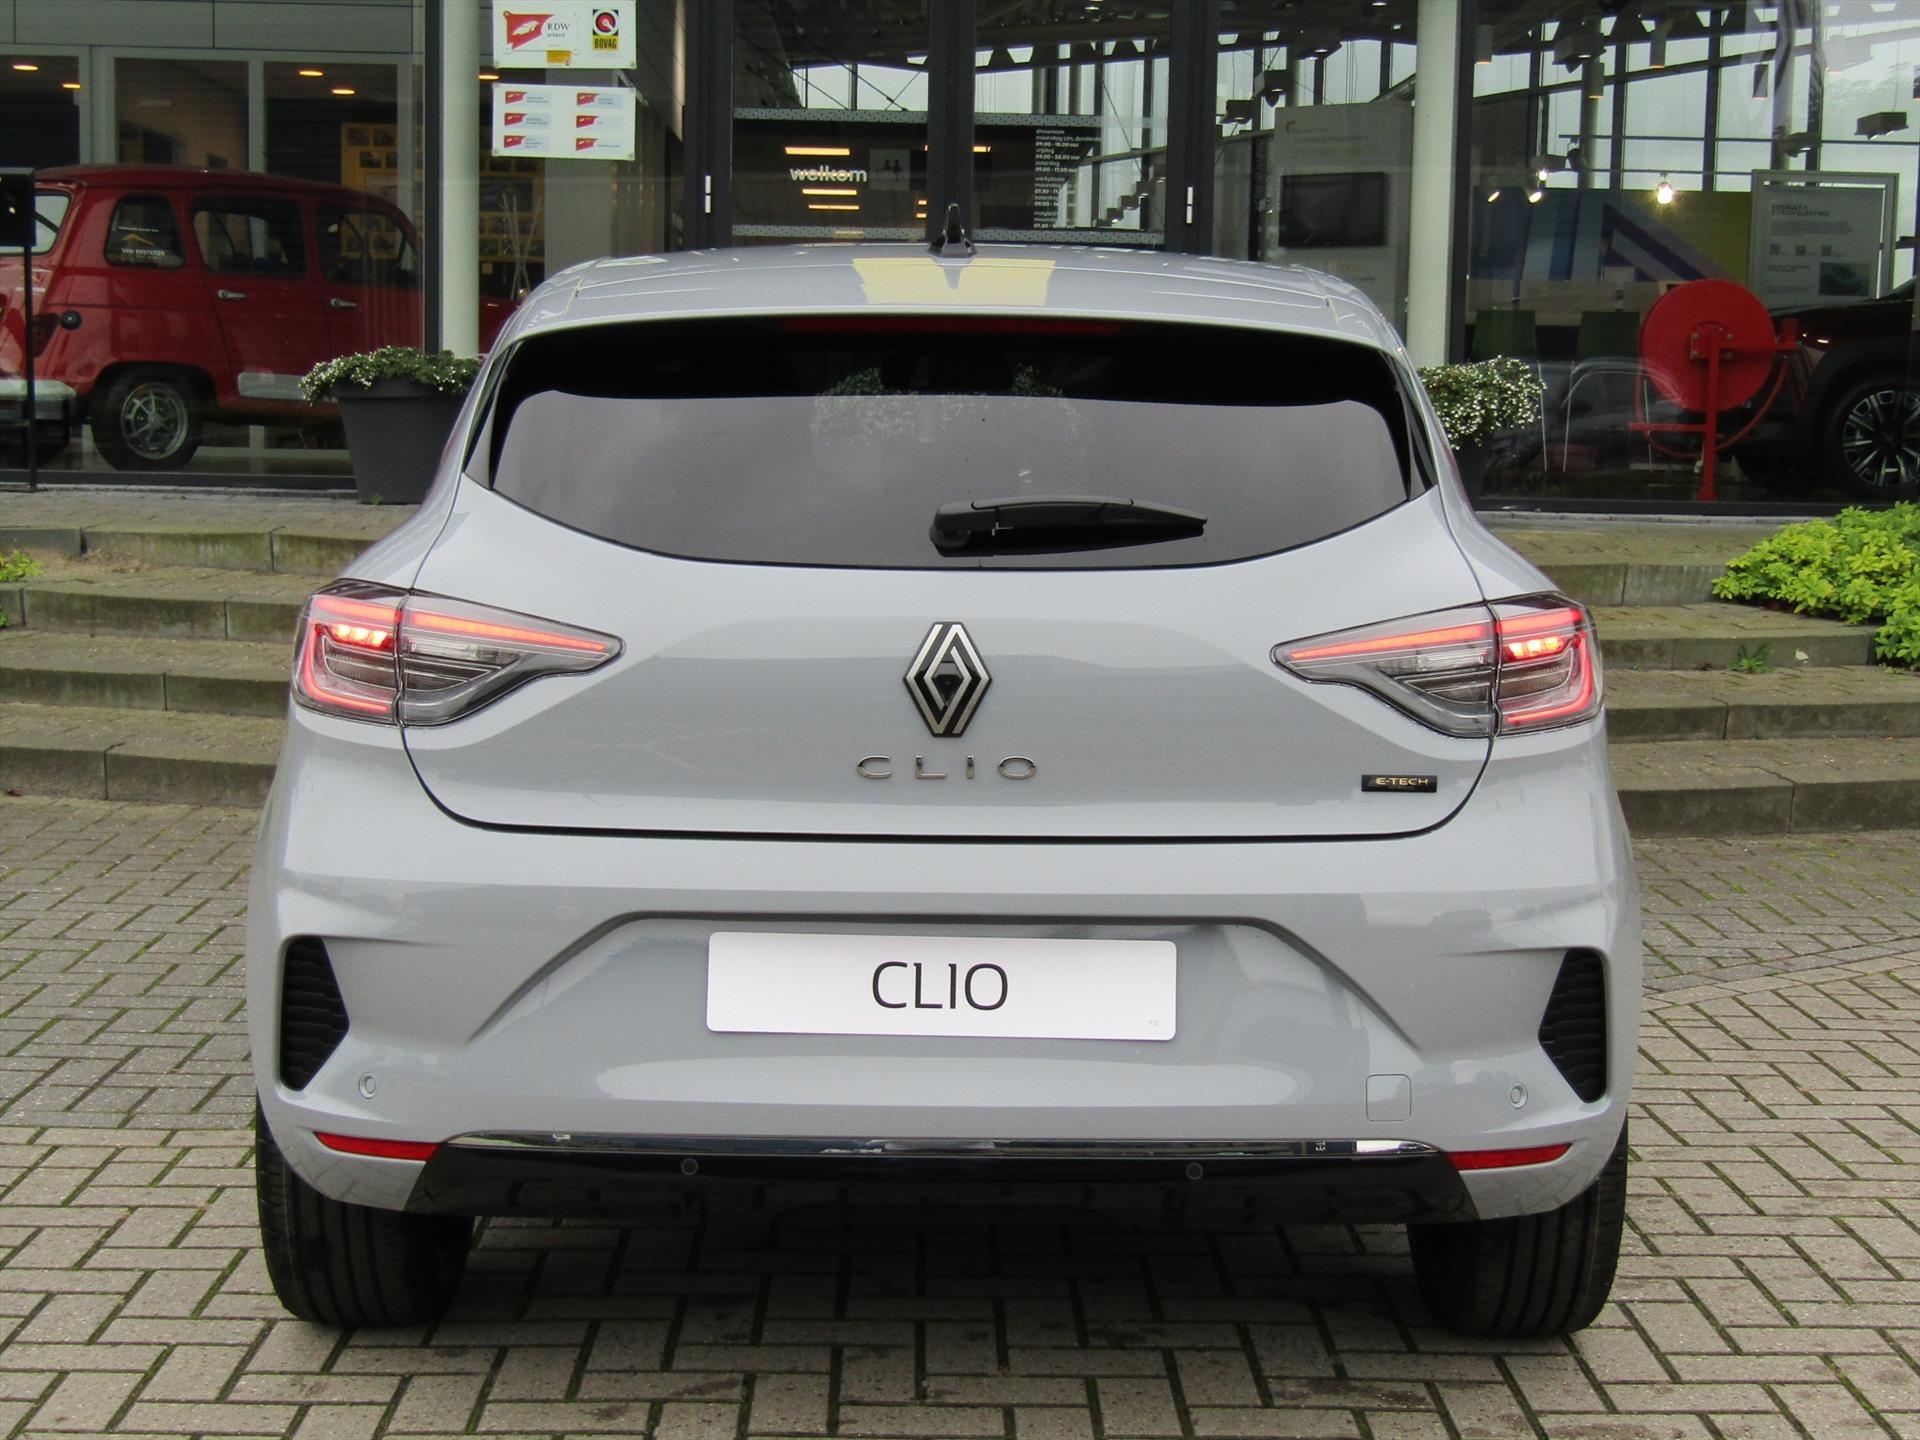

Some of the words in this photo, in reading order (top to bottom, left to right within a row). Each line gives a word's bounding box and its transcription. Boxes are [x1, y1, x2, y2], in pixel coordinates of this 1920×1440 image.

[547, 23, 570, 31] RDW
[594, 38, 617, 49] BOVAG
[790, 165, 867, 182] welkom
[857, 755, 1037, 779] CLIO
[1375, 777, 1428, 786] E-TECH
[872, 961, 1008, 1011] CLIO
